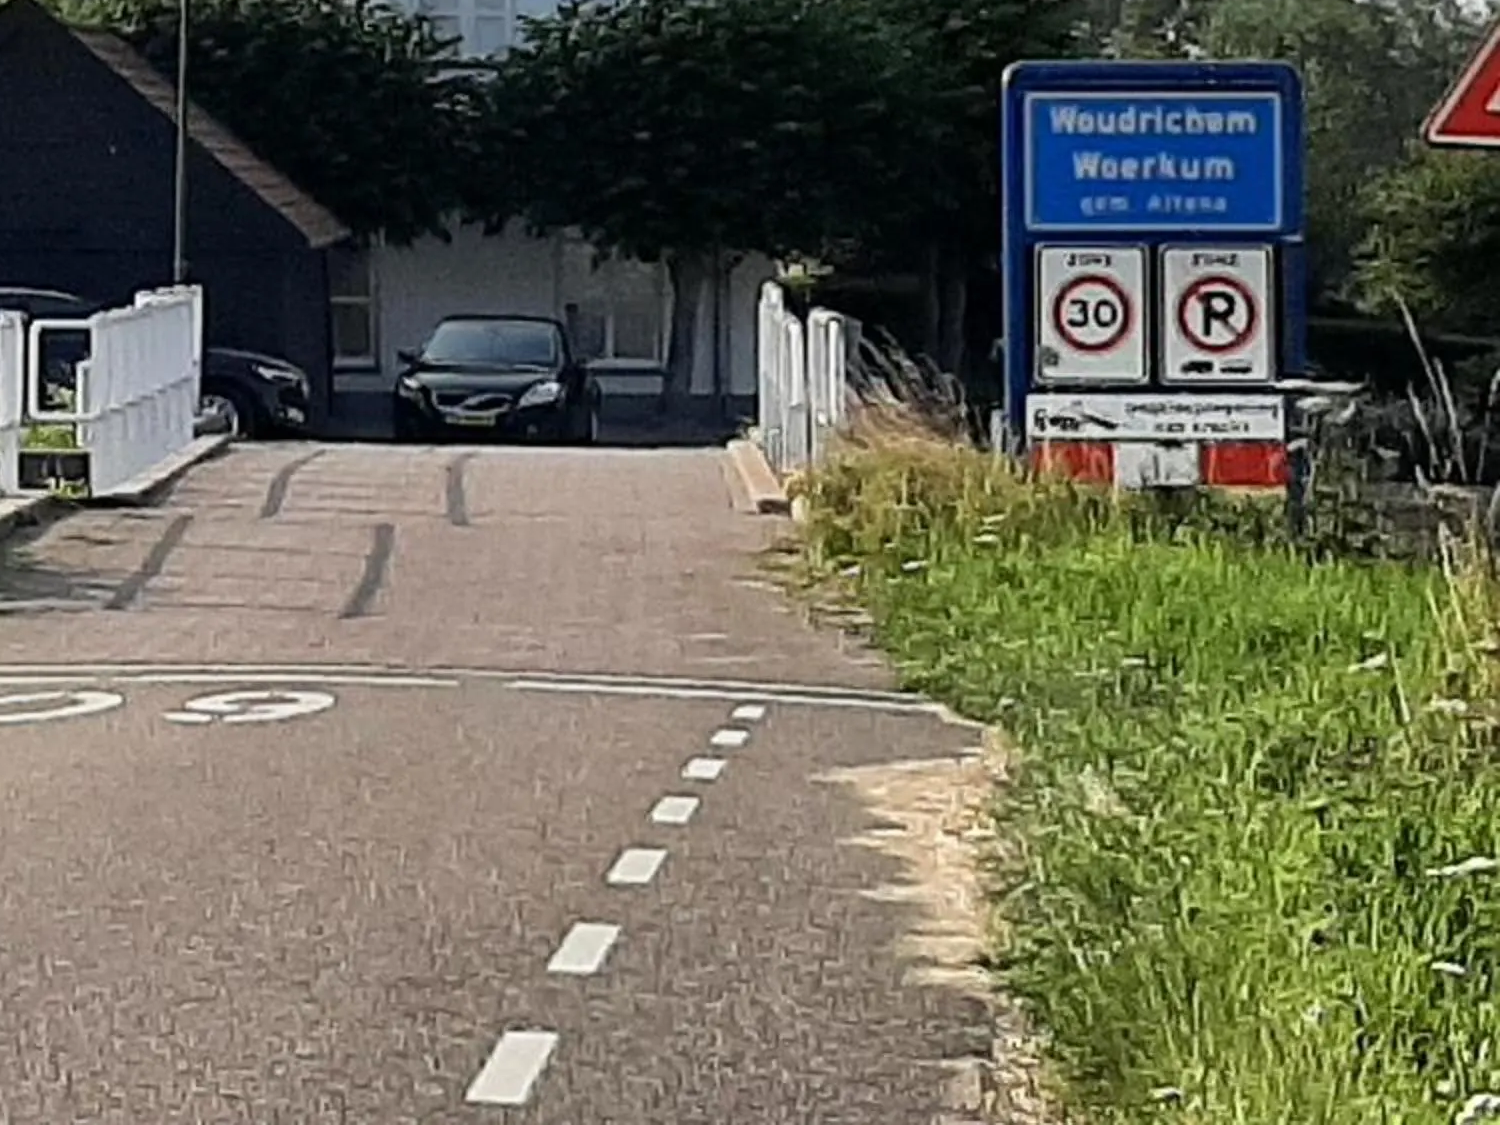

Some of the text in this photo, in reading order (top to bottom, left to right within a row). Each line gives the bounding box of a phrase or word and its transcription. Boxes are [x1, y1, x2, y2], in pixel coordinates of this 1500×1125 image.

[1050, 106, 1256, 134] Woudrichem
[1073, 152, 1235, 180] Woerkum
[1066, 299, 1117, 327] 30
